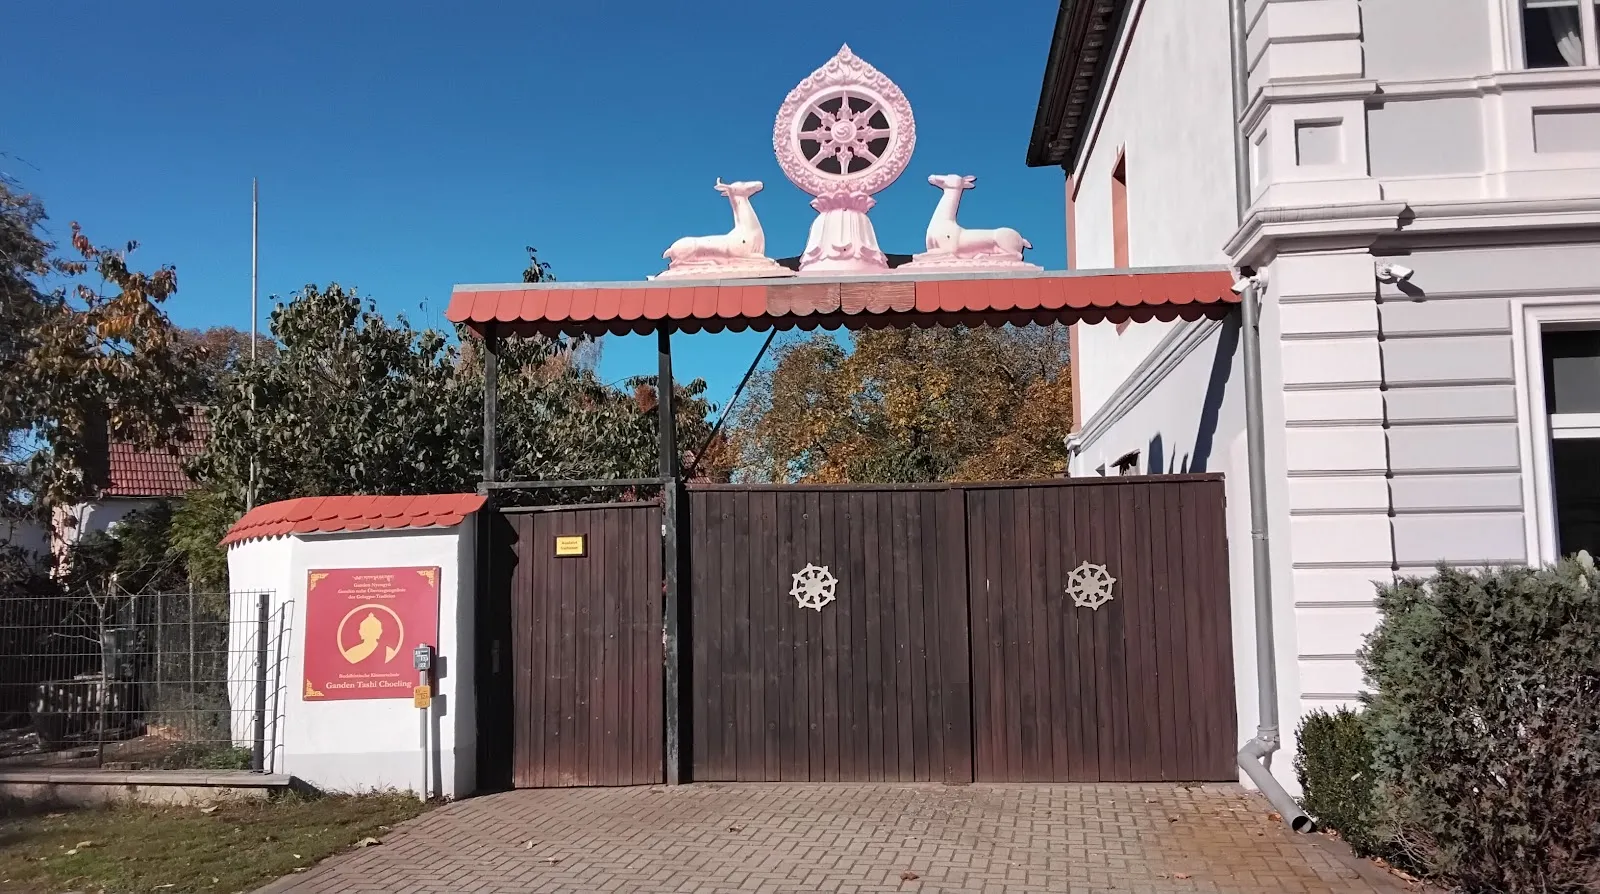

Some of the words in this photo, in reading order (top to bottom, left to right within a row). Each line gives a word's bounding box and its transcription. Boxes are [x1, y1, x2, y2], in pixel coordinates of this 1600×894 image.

[325, 681, 355, 689] Ganden
[356, 681, 377, 689] Tashi
[378, 680, 412, 689] Choeling
